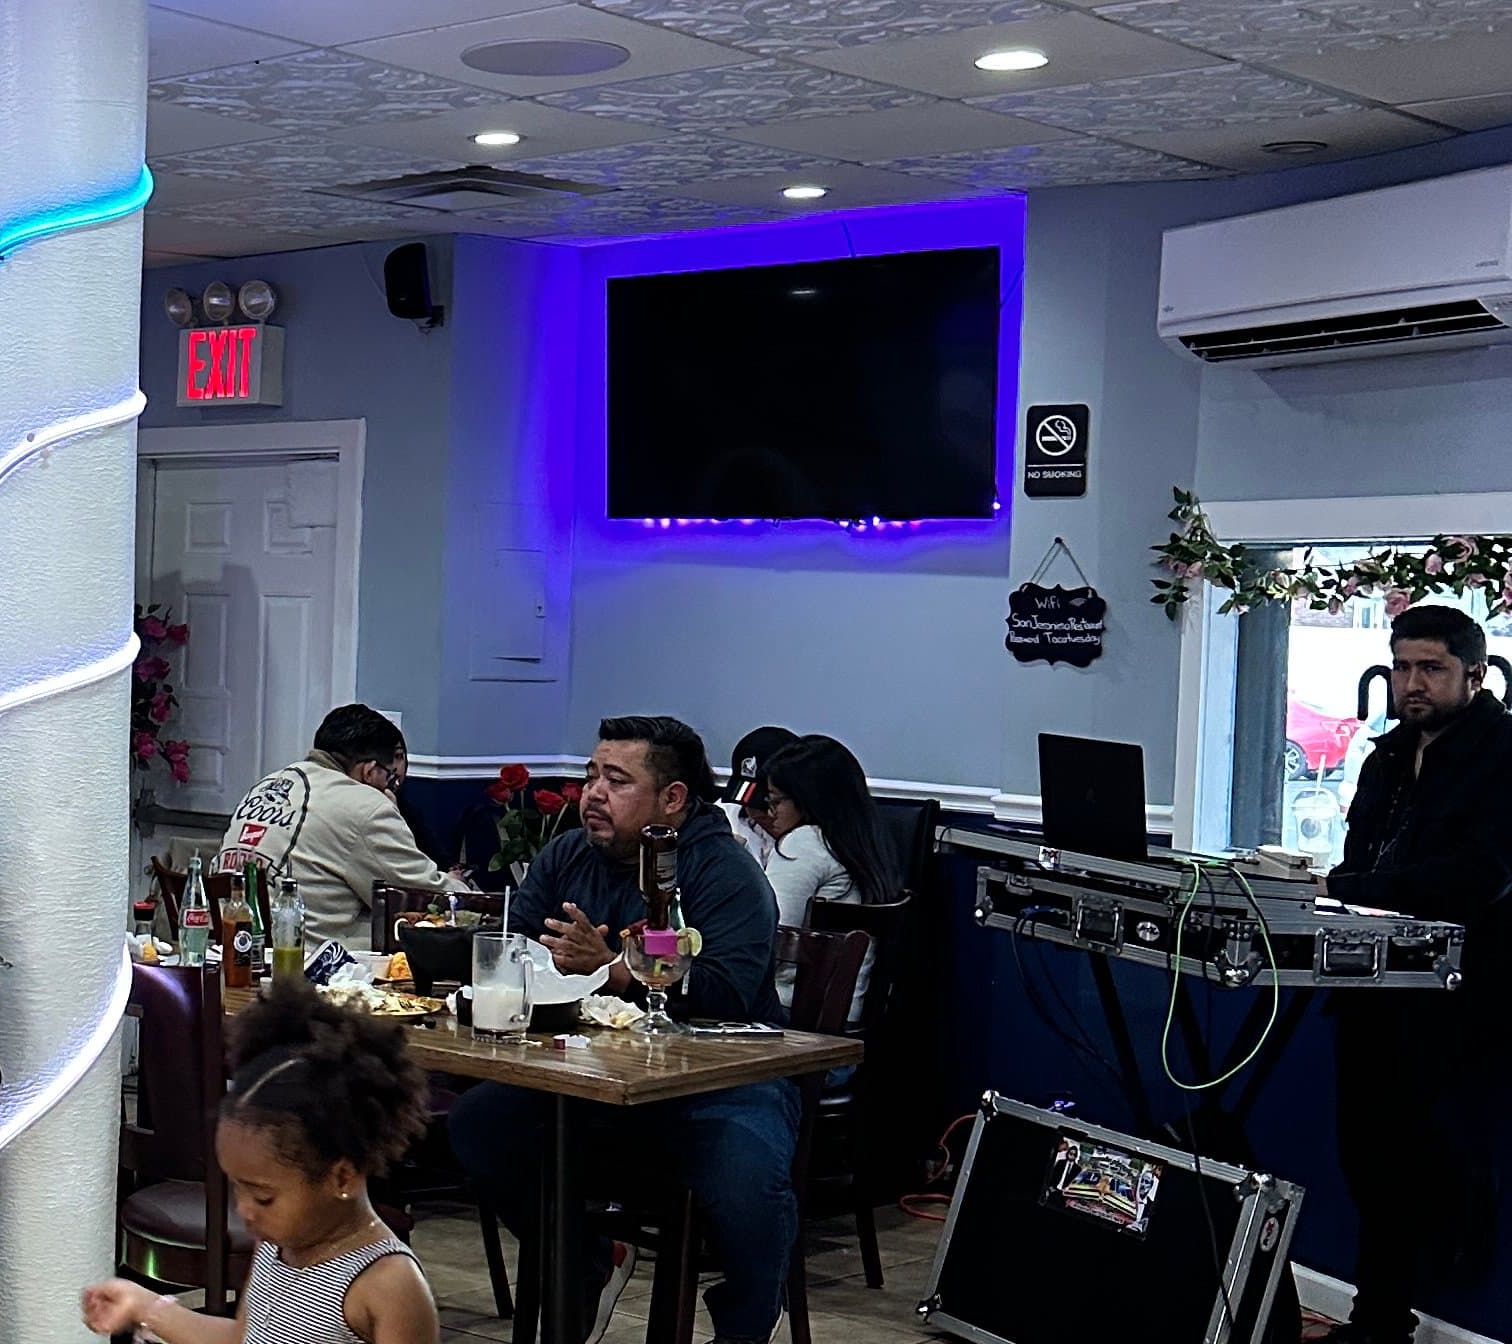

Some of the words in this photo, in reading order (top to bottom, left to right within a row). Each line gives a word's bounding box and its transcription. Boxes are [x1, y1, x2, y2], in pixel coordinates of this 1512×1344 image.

[187, 327, 256, 399] EXIT
[1028, 471, 1040, 479] NO
[1043, 470, 1082, 478] SMOKING
[236, 796, 296, 827] Coors
